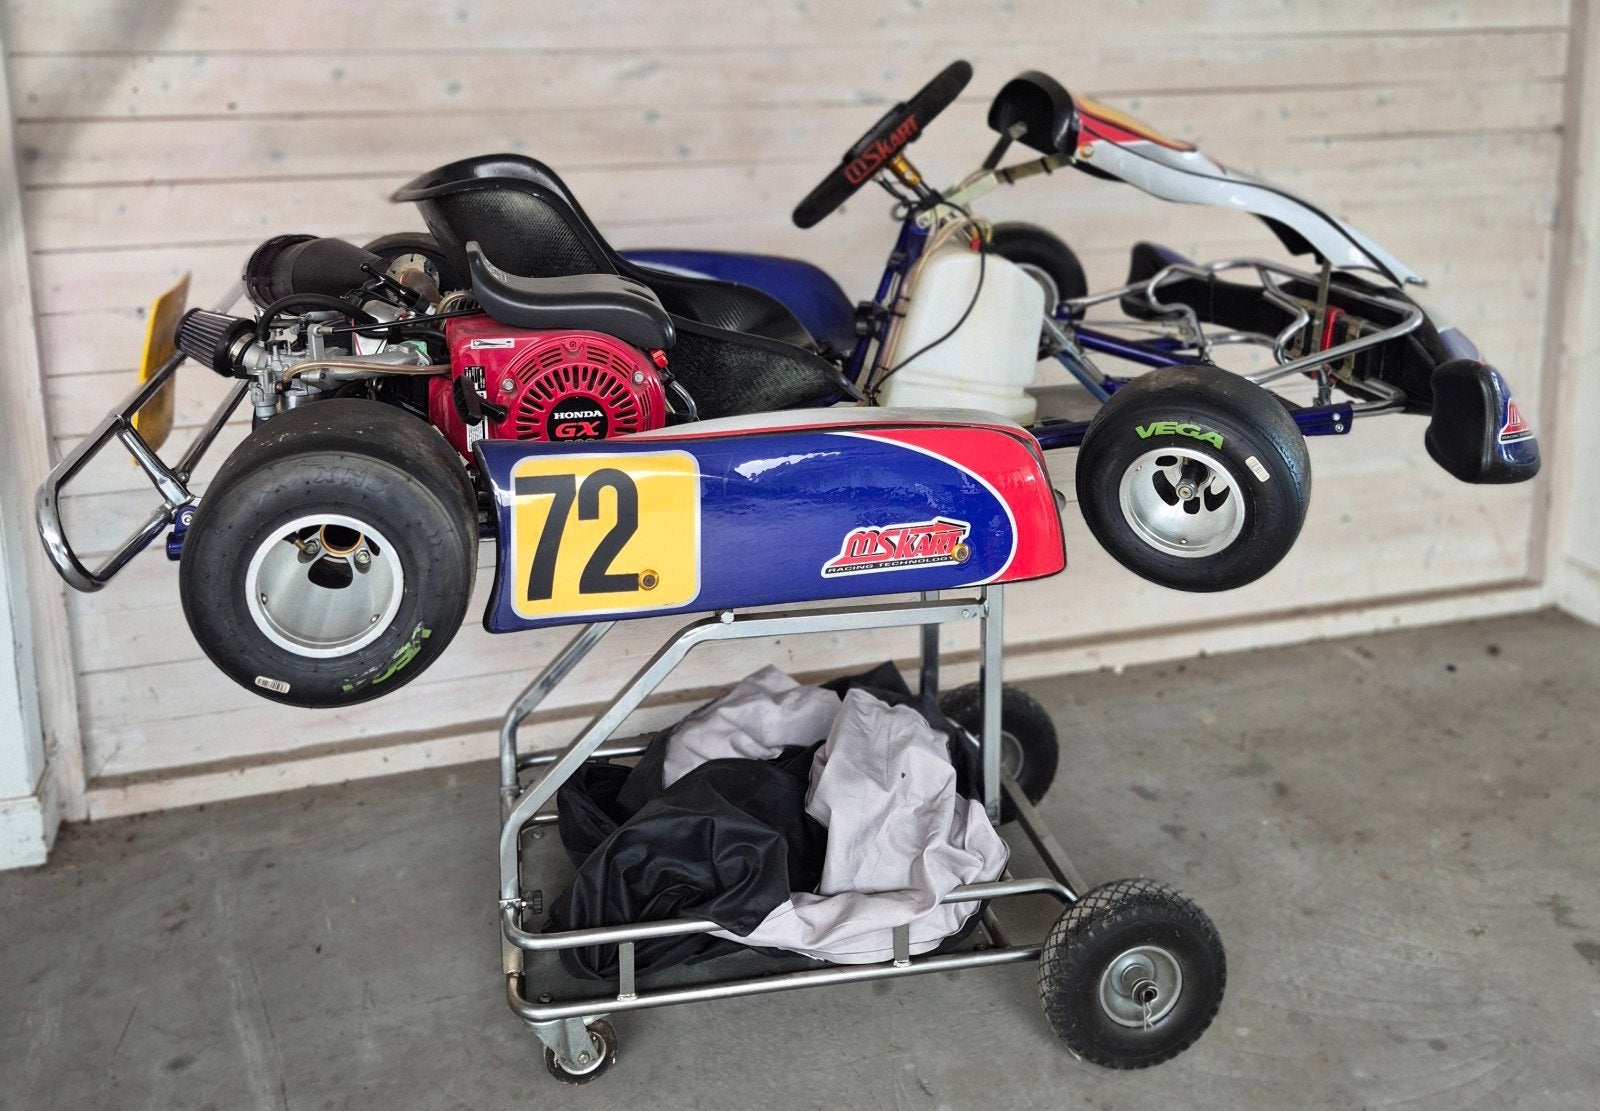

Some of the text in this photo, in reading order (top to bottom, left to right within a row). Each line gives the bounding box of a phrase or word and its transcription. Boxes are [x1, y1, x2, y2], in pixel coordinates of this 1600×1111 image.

[554, 410, 604, 420] HONDA
[555, 421, 601, 437] GX
[1135, 421, 1224, 450] VEGA
[515, 468, 639, 601] 72
[828, 563, 874, 574] RACING
